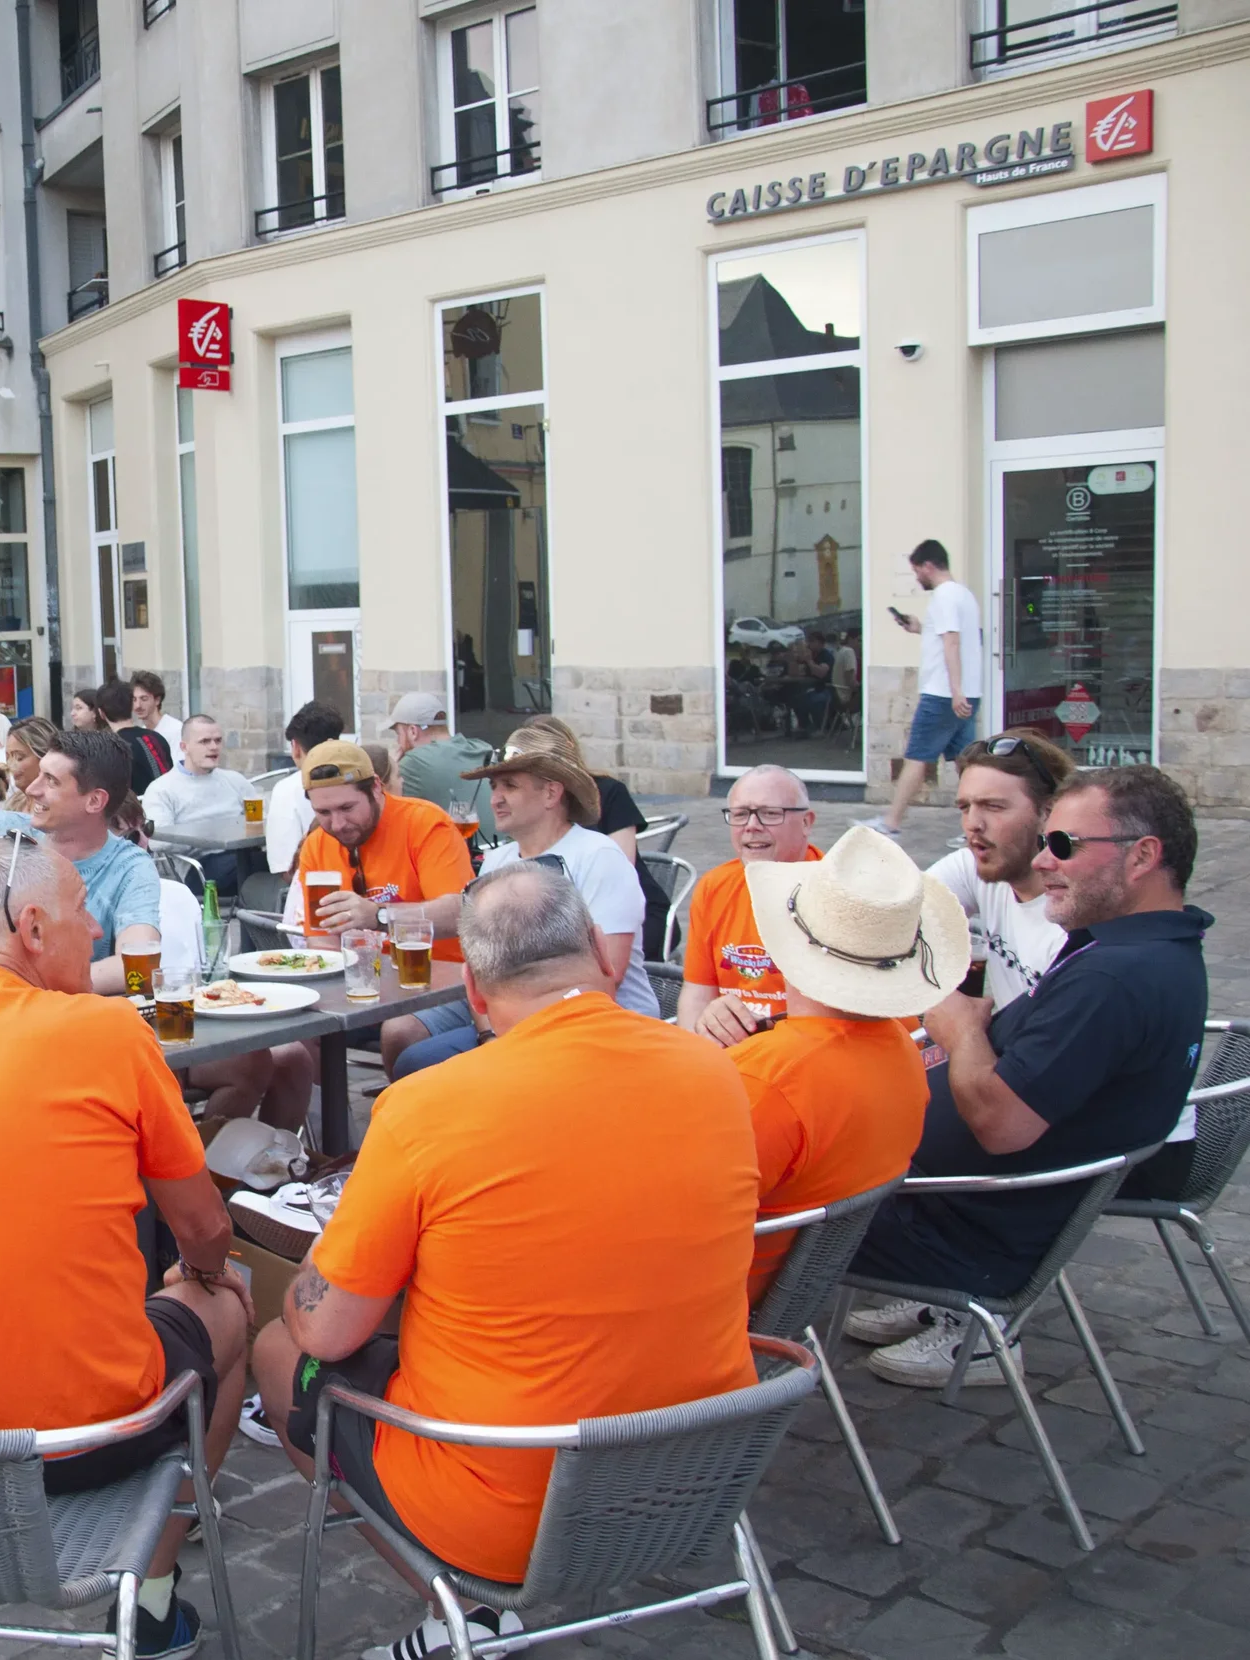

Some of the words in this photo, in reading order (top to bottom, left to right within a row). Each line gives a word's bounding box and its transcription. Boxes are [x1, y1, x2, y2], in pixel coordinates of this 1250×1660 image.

[976, 171, 1009, 183] Hauts
[1012, 167, 1026, 177] de
[1029, 159, 1069, 173] France
[706, 172, 826, 218] CAISSE
[752, 989, 788, 1000] Barcelo
[743, 1001, 771, 1018] 024
